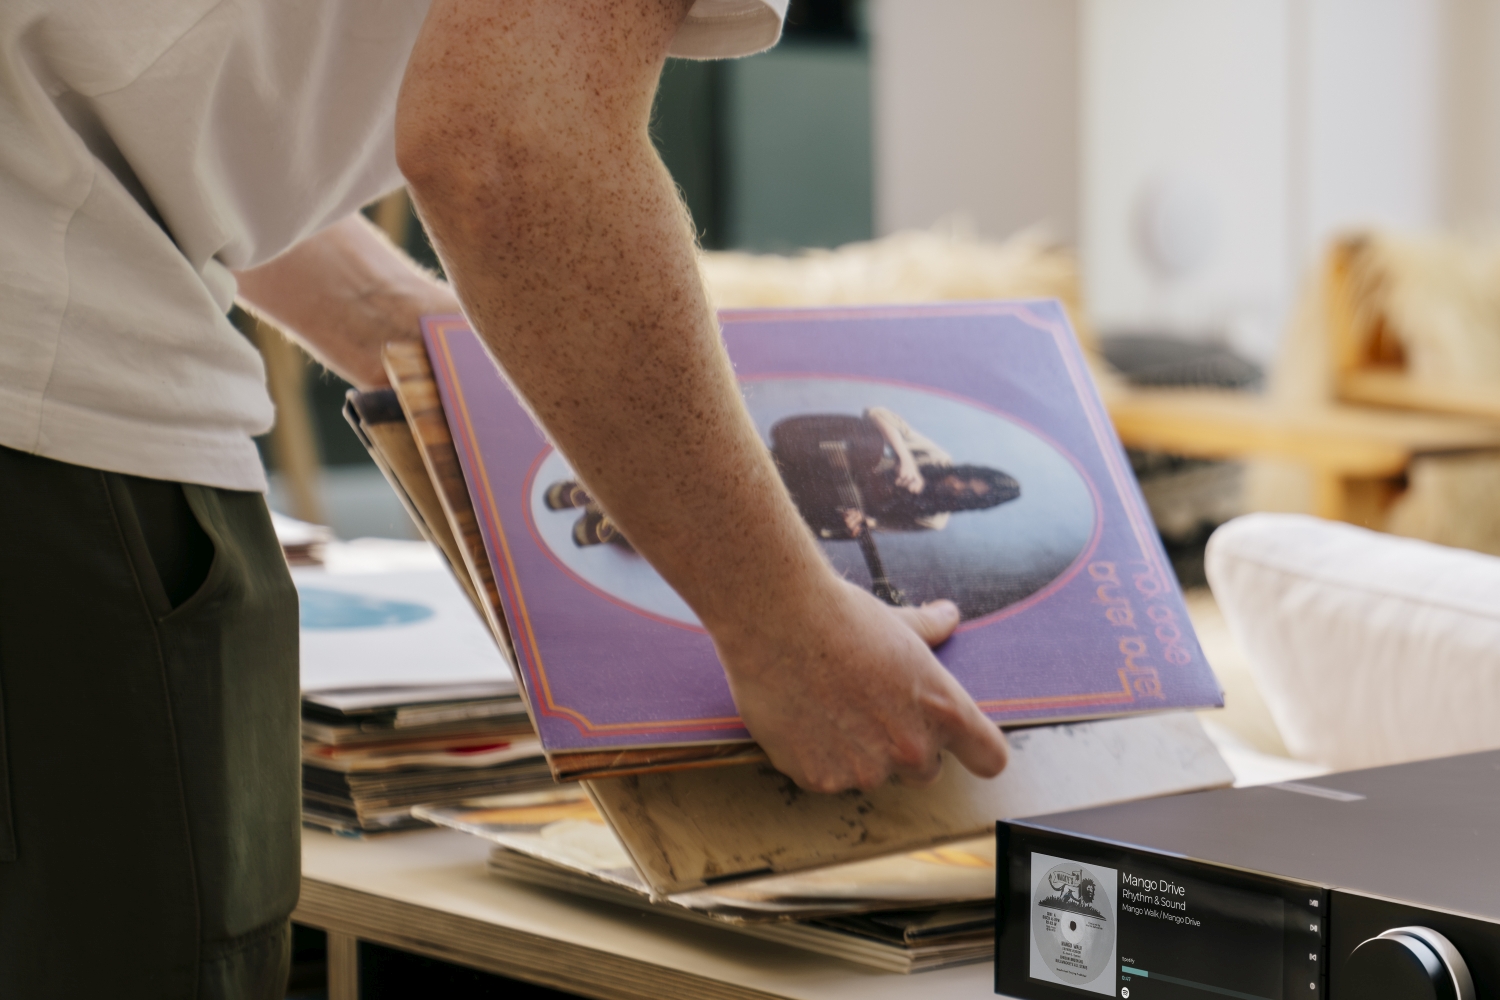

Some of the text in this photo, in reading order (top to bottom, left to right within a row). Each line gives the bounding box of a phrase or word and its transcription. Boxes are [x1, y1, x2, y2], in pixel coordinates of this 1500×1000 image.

[1122, 871, 1186, 897] Mango Drive
[1122, 888, 1186, 911] Rhythm & Sound
[1122, 903, 1144, 916] Mango
[1143, 907, 1159, 918] Walk
[1162, 912, 1184, 925] Mango
[1185, 916, 1201, 927] Drive
